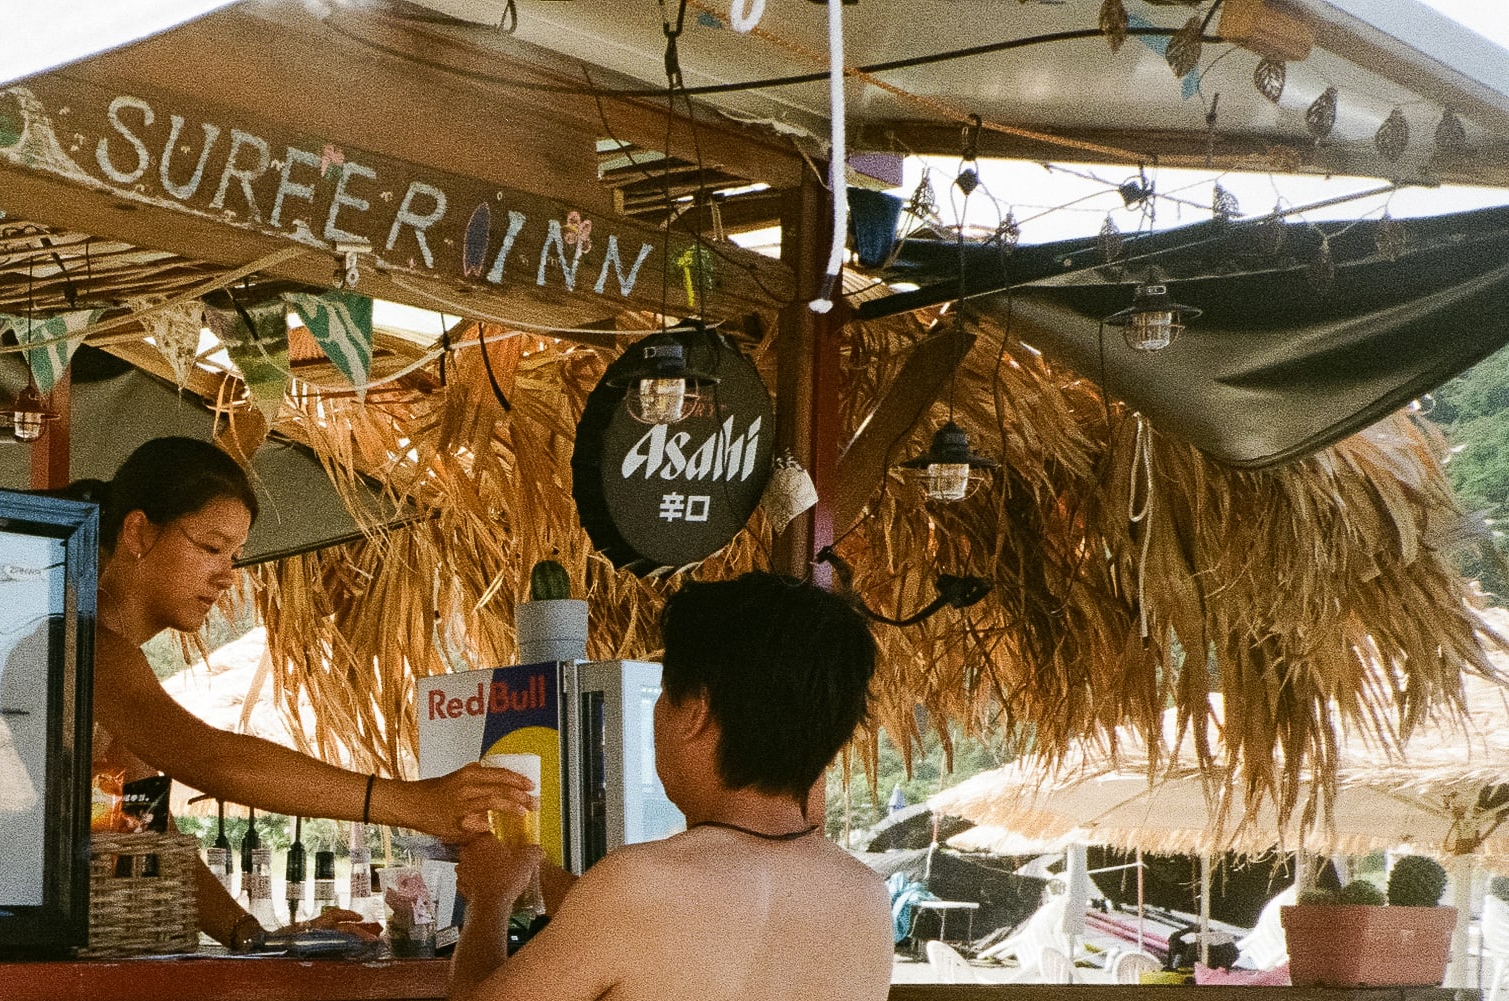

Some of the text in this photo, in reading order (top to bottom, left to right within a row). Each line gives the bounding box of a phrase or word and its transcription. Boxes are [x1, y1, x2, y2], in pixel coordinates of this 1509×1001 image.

[95, 95, 654, 297] SURFER INN
[621, 414, 762, 482] Asahi
[659, 491, 711, 522] 辛口
[427, 674, 546, 720] Red Bull
